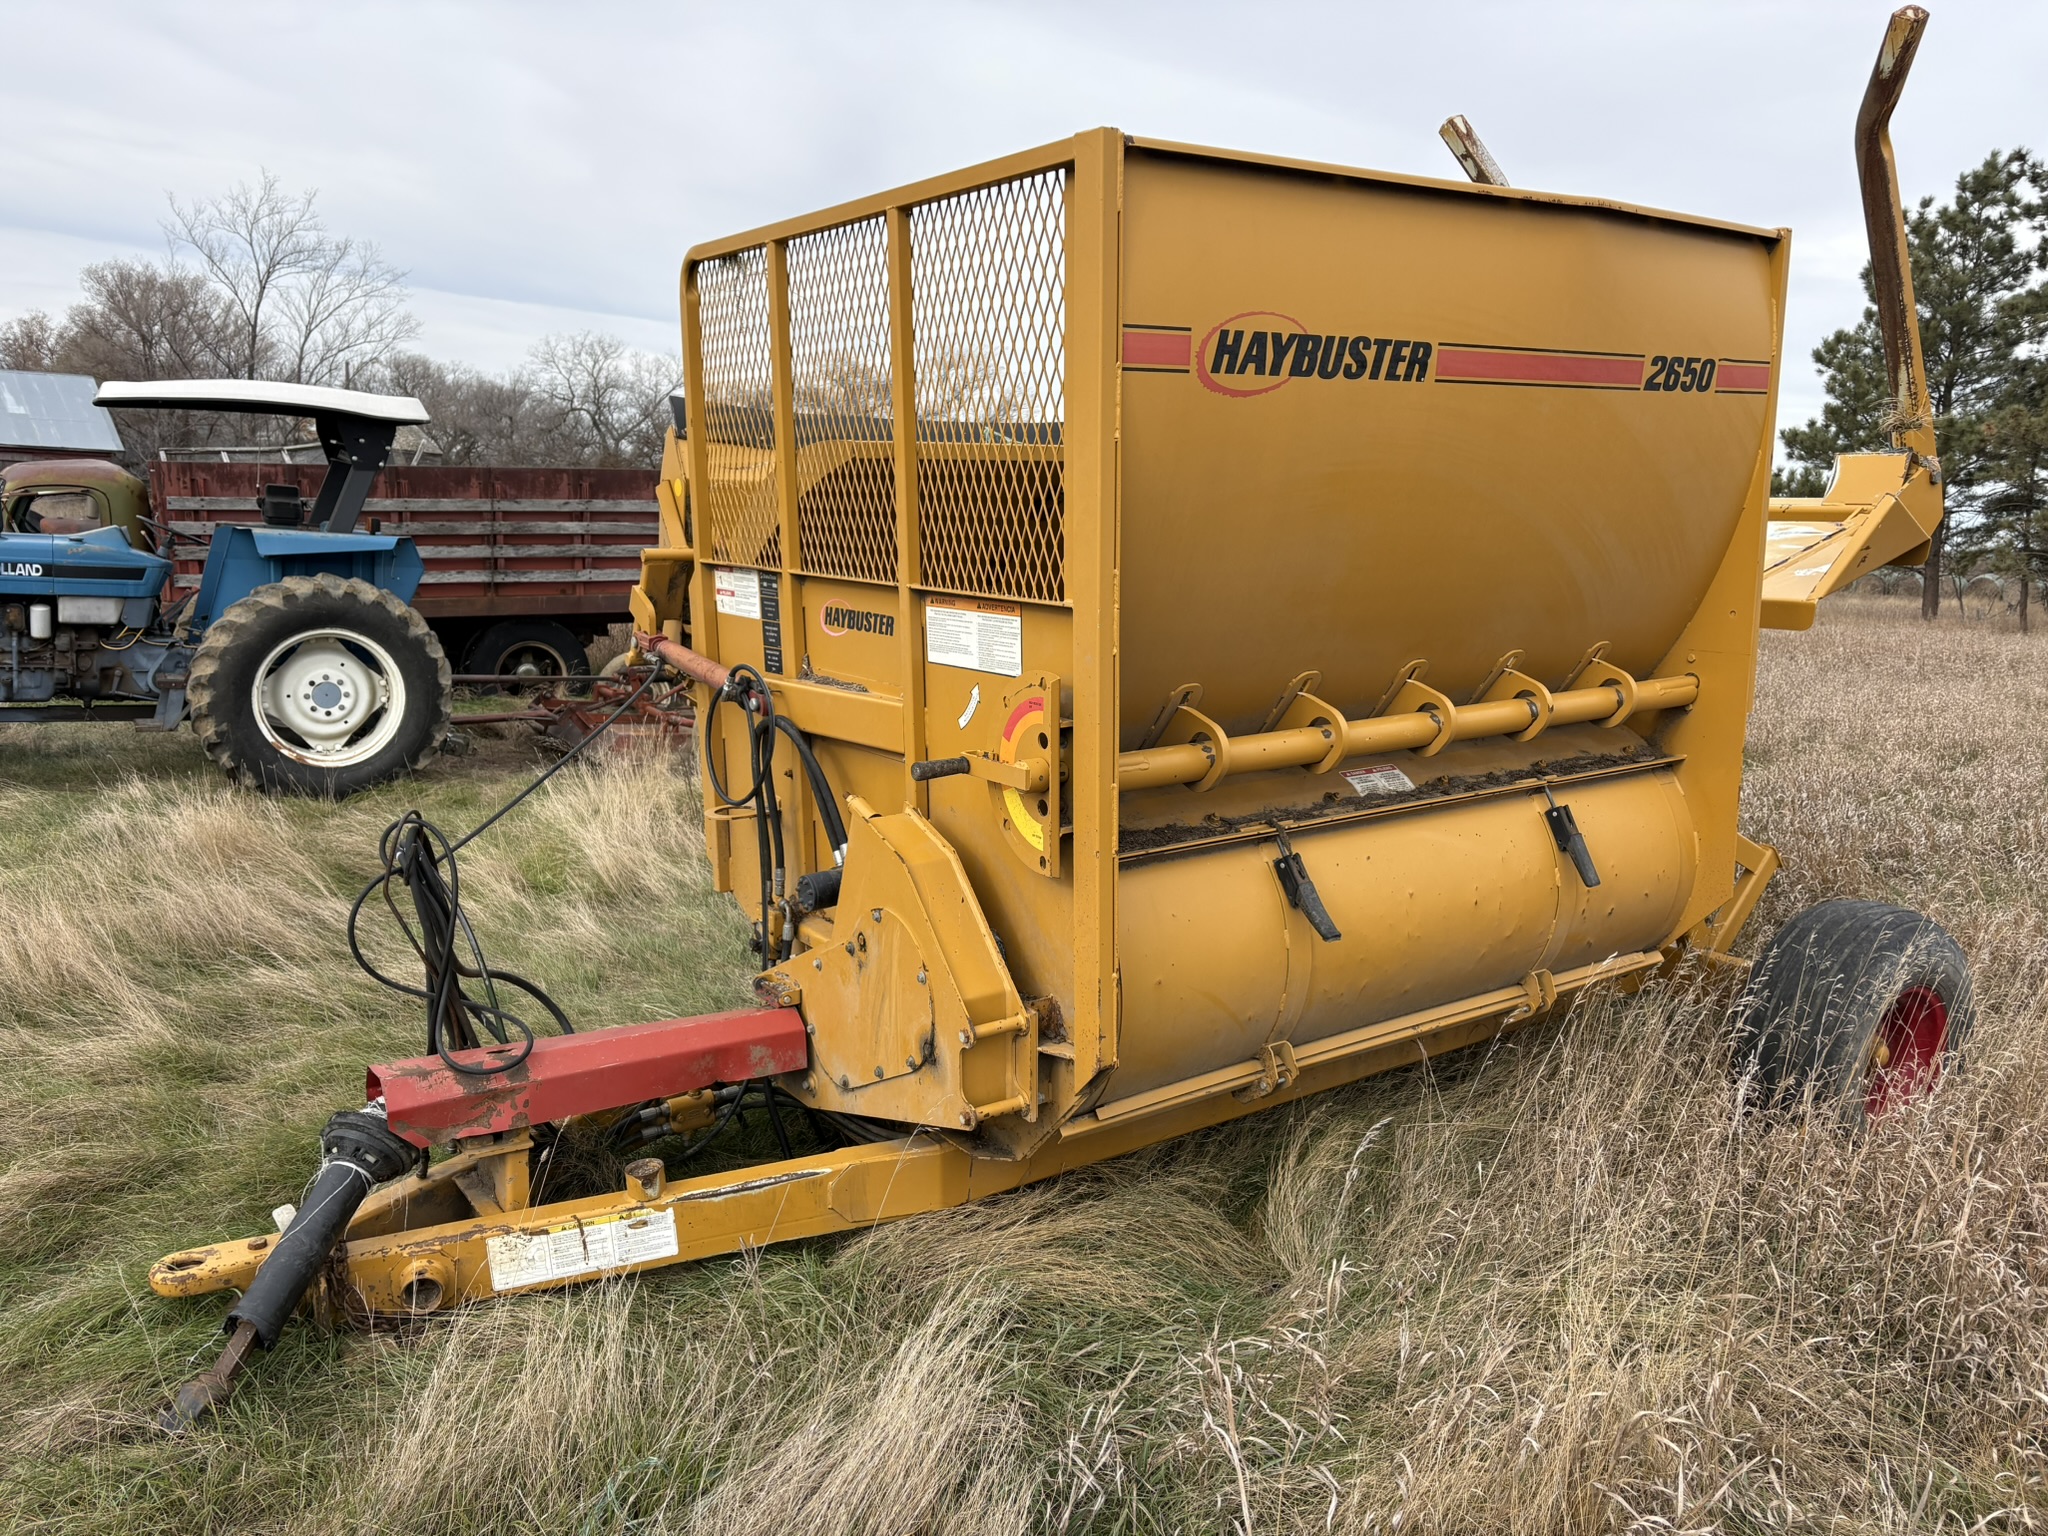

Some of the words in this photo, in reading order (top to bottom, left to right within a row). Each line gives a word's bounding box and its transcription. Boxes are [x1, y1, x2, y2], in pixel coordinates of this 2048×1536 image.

[1210, 329, 1433, 382] HAYBUSTER
[1643, 355, 1716, 392] 2650
[825, 606, 895, 636] HAYBUSTER
[981, 602, 1016, 613] ADVERTENCIA
